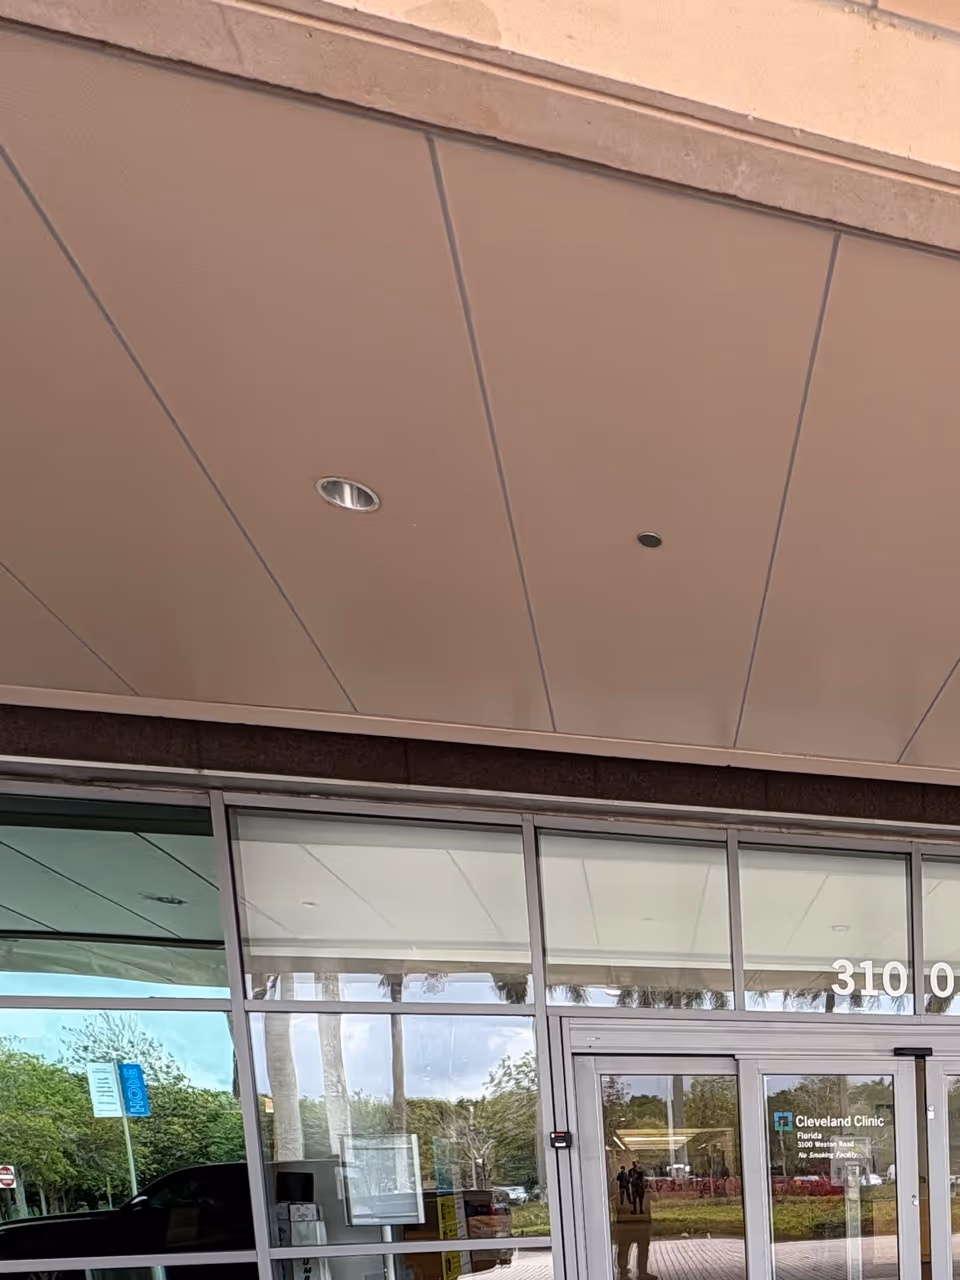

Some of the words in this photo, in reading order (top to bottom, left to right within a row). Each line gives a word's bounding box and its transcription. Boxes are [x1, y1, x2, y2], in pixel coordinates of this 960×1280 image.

[795, 1115, 851, 1127] Cleveland
[854, 1115, 885, 1127] Clinic
[797, 1132, 822, 1140] Florida
